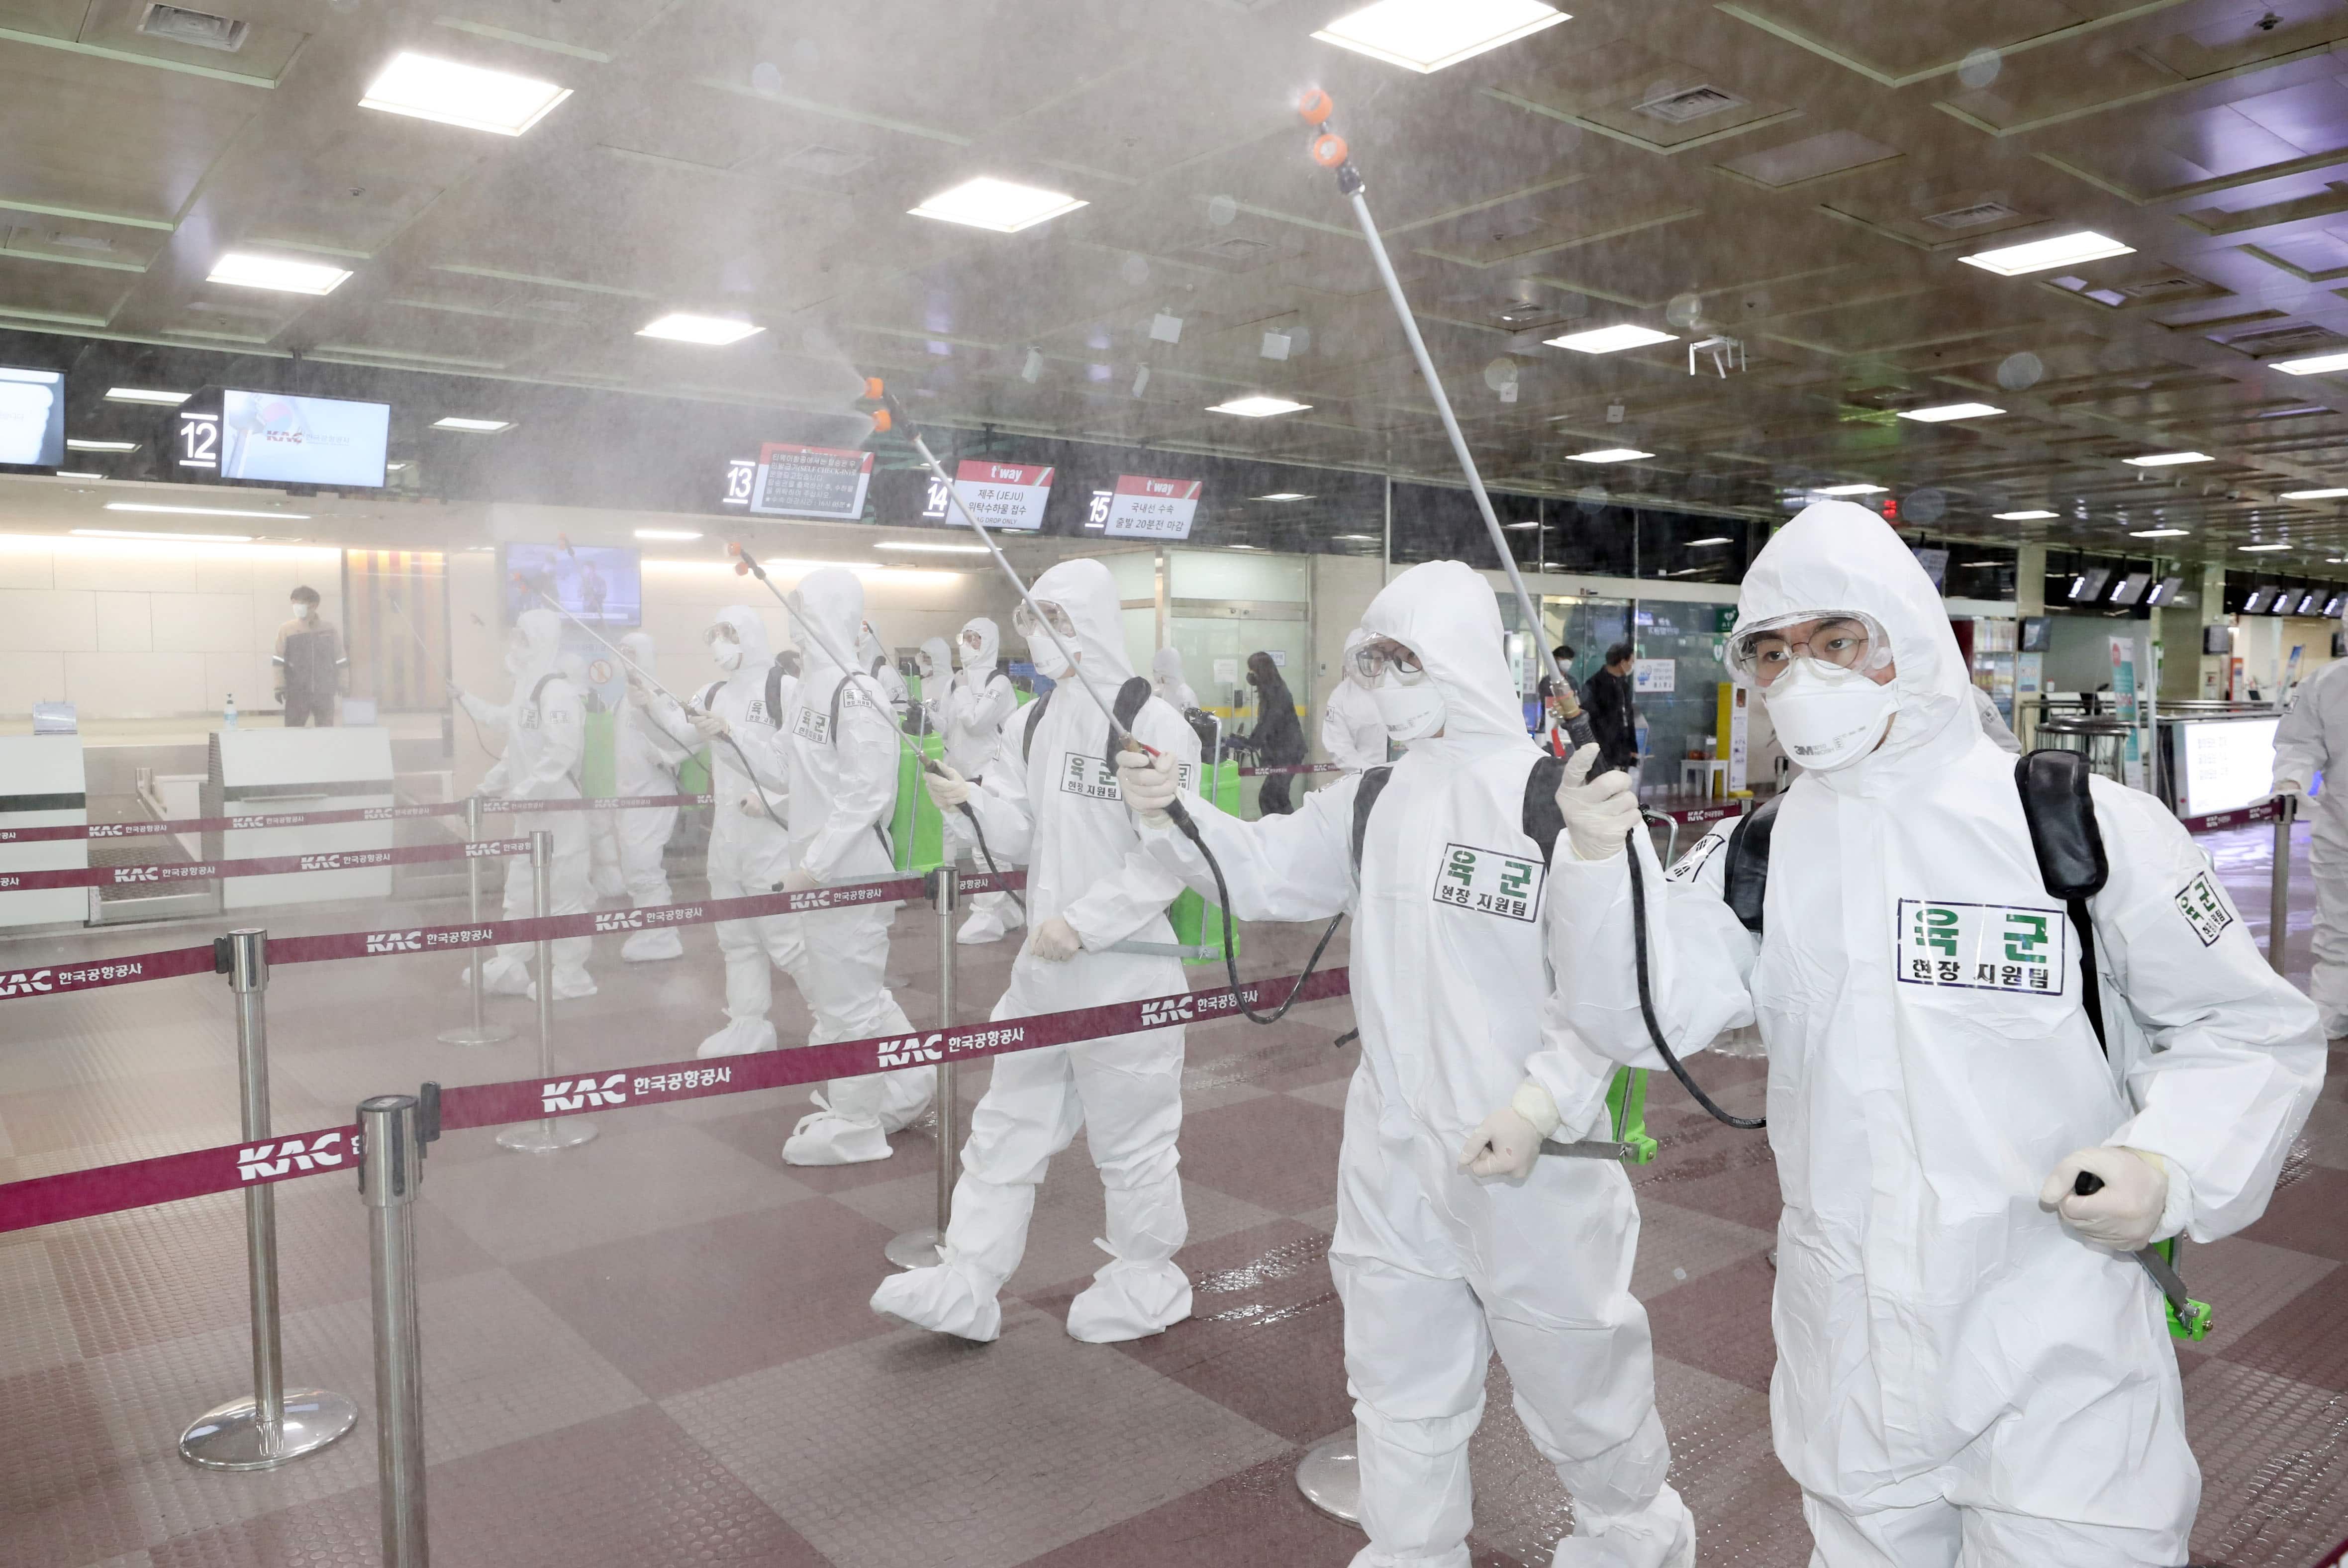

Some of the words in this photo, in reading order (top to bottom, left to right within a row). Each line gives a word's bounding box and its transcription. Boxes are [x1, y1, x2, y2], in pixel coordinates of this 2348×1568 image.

[180, 421, 217, 460] 12
[727, 467, 755, 497] 13
[927, 483, 948, 511] 14
[978, 490, 994, 499] 제주
[996, 491, 1024, 501] (JEJU)
[969, 501, 1009, 514] 위탁수하물
[1011, 505, 1026, 515] 접수
[1090, 497, 1110, 522] 15
[1131, 502, 1156, 513] 국내선
[1158, 504, 1174, 514] 수속
[1115, 517, 1134, 529] 출발
[1135, 520, 1164, 530] 20분전
[1167, 521, 1183, 531] 마감
[1794, 745, 1814, 755] 3M
[1070, 757, 1084, 781] 육
[697, 794, 713, 803] KA
[1086, 784, 1116, 797] 지원팀
[483, 801, 509, 812] KAC
[594, 798, 618, 807] KAC
[233, 816, 264, 828] KAC
[266, 815, 304, 824] 한국공항공사
[364, 808, 392, 819] KAC
[1687, 810, 1703, 821] KAC
[89, 825, 122, 836] KAC
[466, 842, 500, 856] KAC
[503, 842, 531, 851] 한국공항
[301, 855, 340, 870] KAC
[343, 853, 391, 864] 한국공항공사
[114, 867, 158, 882] KAC
[162, 866, 215, 877] 한국공항공사
[1447, 850, 1476, 886] 육
[1500, 861, 1533, 899] 군
[959, 878, 988, 890] 공항공사
[789, 890, 830, 910] KAC
[834, 888, 882, 902] 한국공항공사
[1442, 885, 1470, 904] 현장
[1477, 893, 1527, 917] 지원팀
[595, 910, 642, 931] KAC
[646, 906, 703, 923] 한국공항공사
[366, 931, 421, 952] KAC
[427, 929, 492, 944] 한국공항공사
[1914, 908, 1959, 956] 육
[2003, 913, 2048, 964] 군
[0, 970, 52, 995] AC
[58, 963, 142, 985] 한국공항공사
[1913, 959, 1960, 981] 현장
[1973, 963, 2049, 989] 지원팀
[1141, 996, 1193, 1026] KAC
[877, 1034, 944, 1068] KAC
[948, 1028, 1024, 1054] 한국공항공사
[541, 1074, 626, 1112] KAC
[633, 1066, 731, 1094] 한국공항공사
[237, 1132, 342, 1180] KAC
